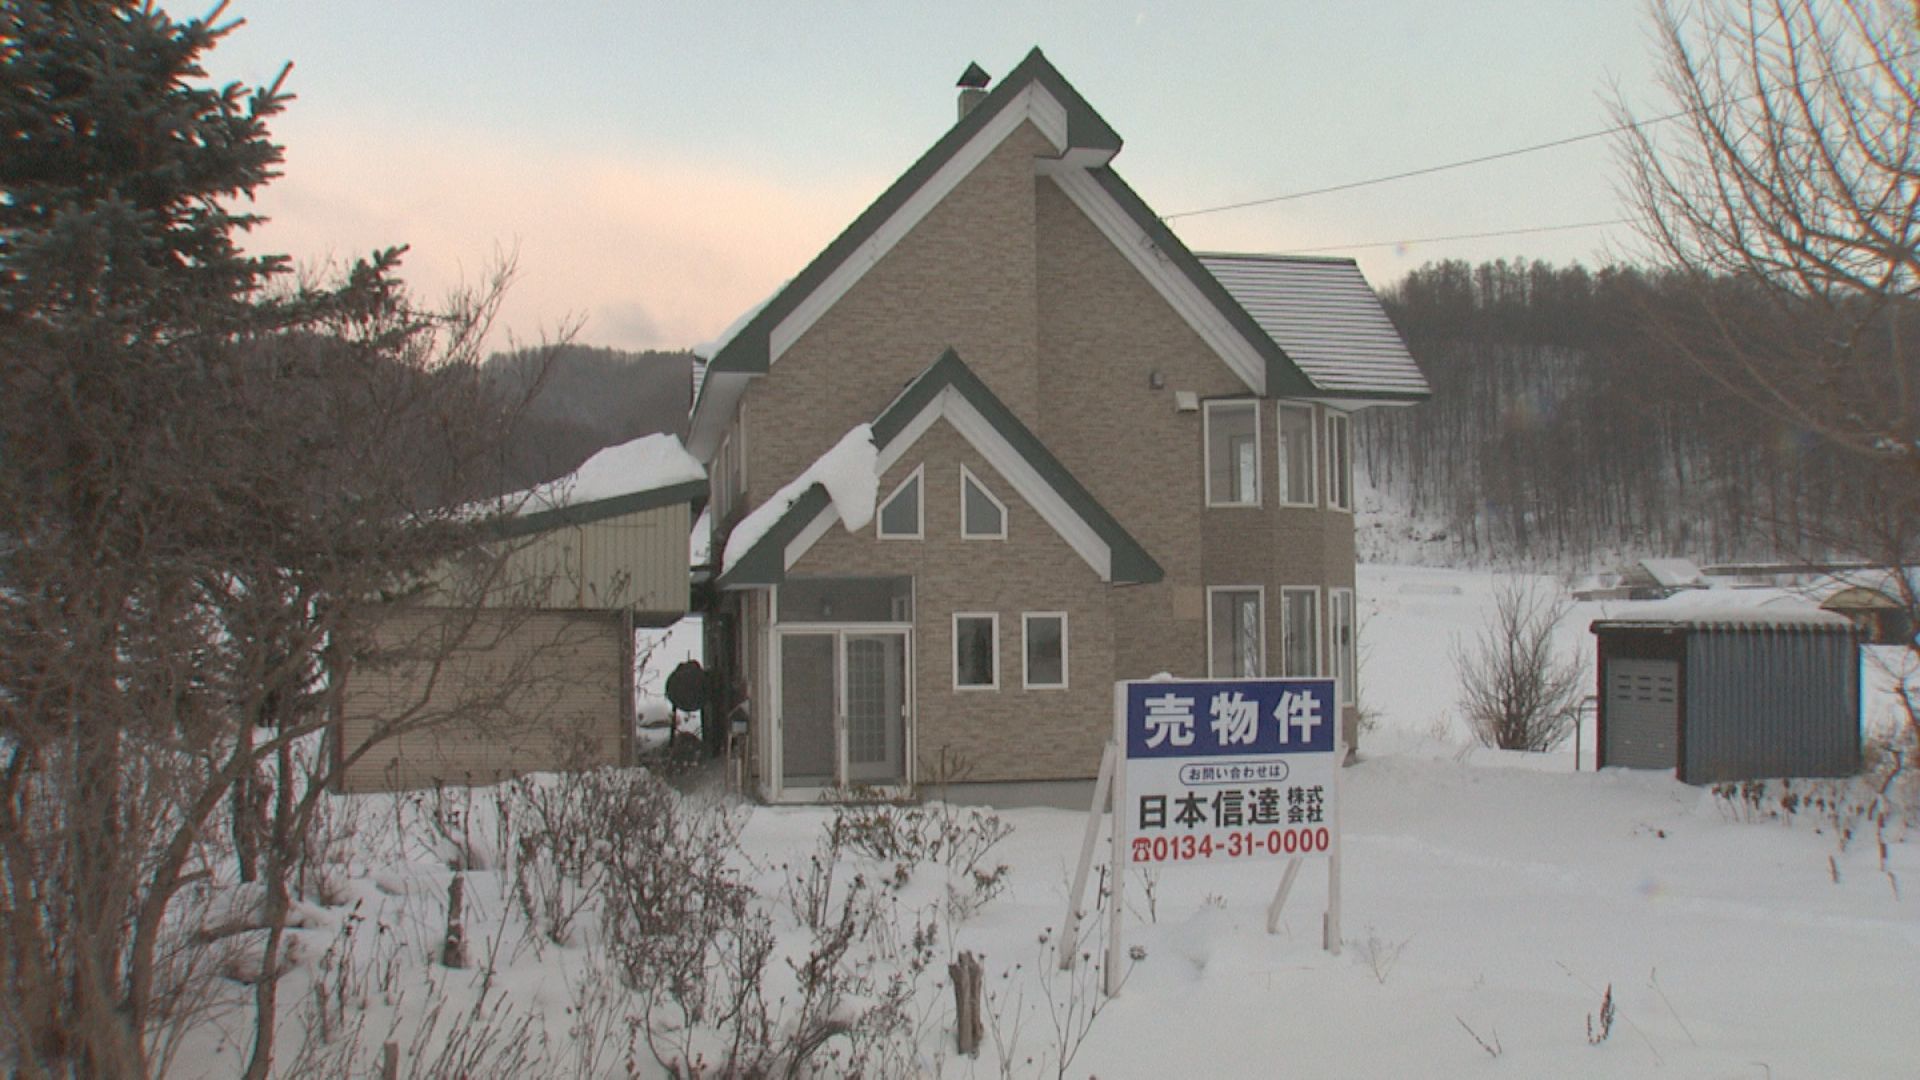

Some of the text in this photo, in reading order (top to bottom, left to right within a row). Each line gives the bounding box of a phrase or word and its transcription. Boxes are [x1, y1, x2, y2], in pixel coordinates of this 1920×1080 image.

[1144, 690, 1322, 748] 売物件
[1189, 765, 1281, 781] お問い合わせは
[1139, 787, 1280, 829] 日本信達
[1288, 785, 1324, 805] 株式
[1288, 805, 1324, 824] 会社
[1153, 827, 1329, 861] 0134-31-0000
